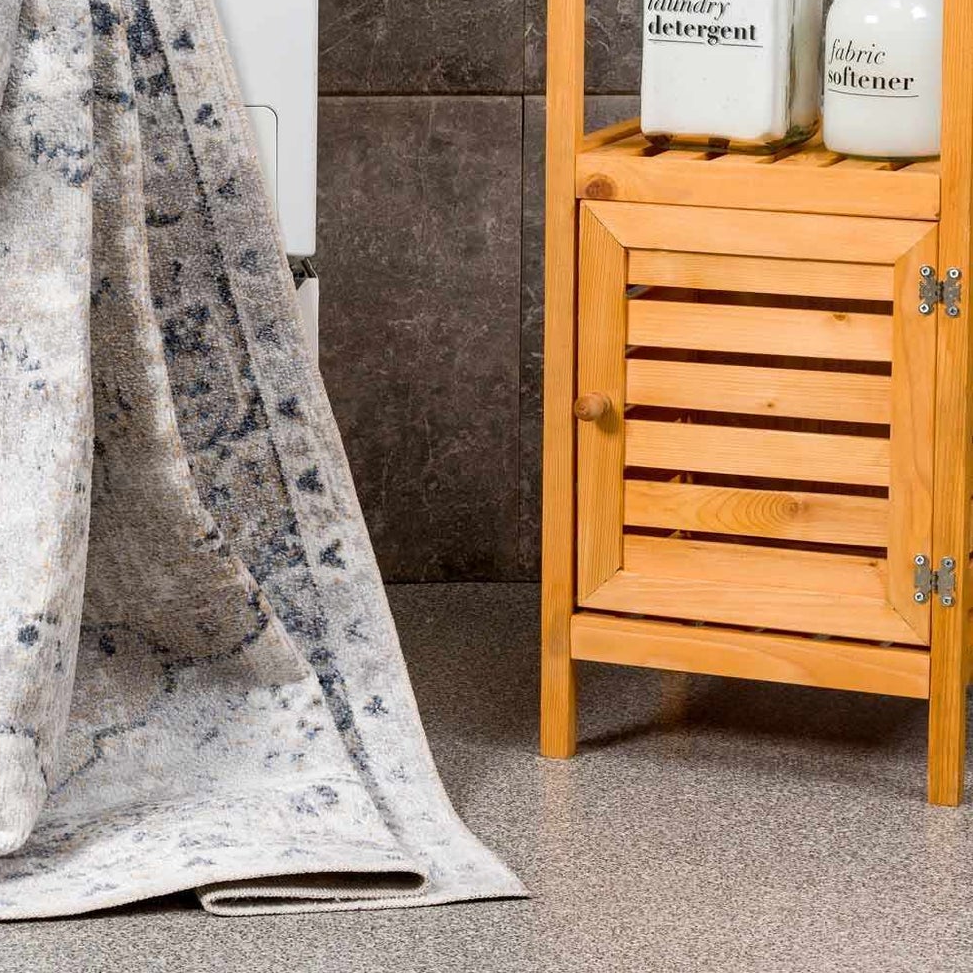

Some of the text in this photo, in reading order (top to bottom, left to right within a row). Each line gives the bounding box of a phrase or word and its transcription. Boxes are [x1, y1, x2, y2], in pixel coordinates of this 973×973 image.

[648, 15, 756, 46] detergent
[828, 38, 886, 65] fabric
[828, 66, 914, 90] softener
